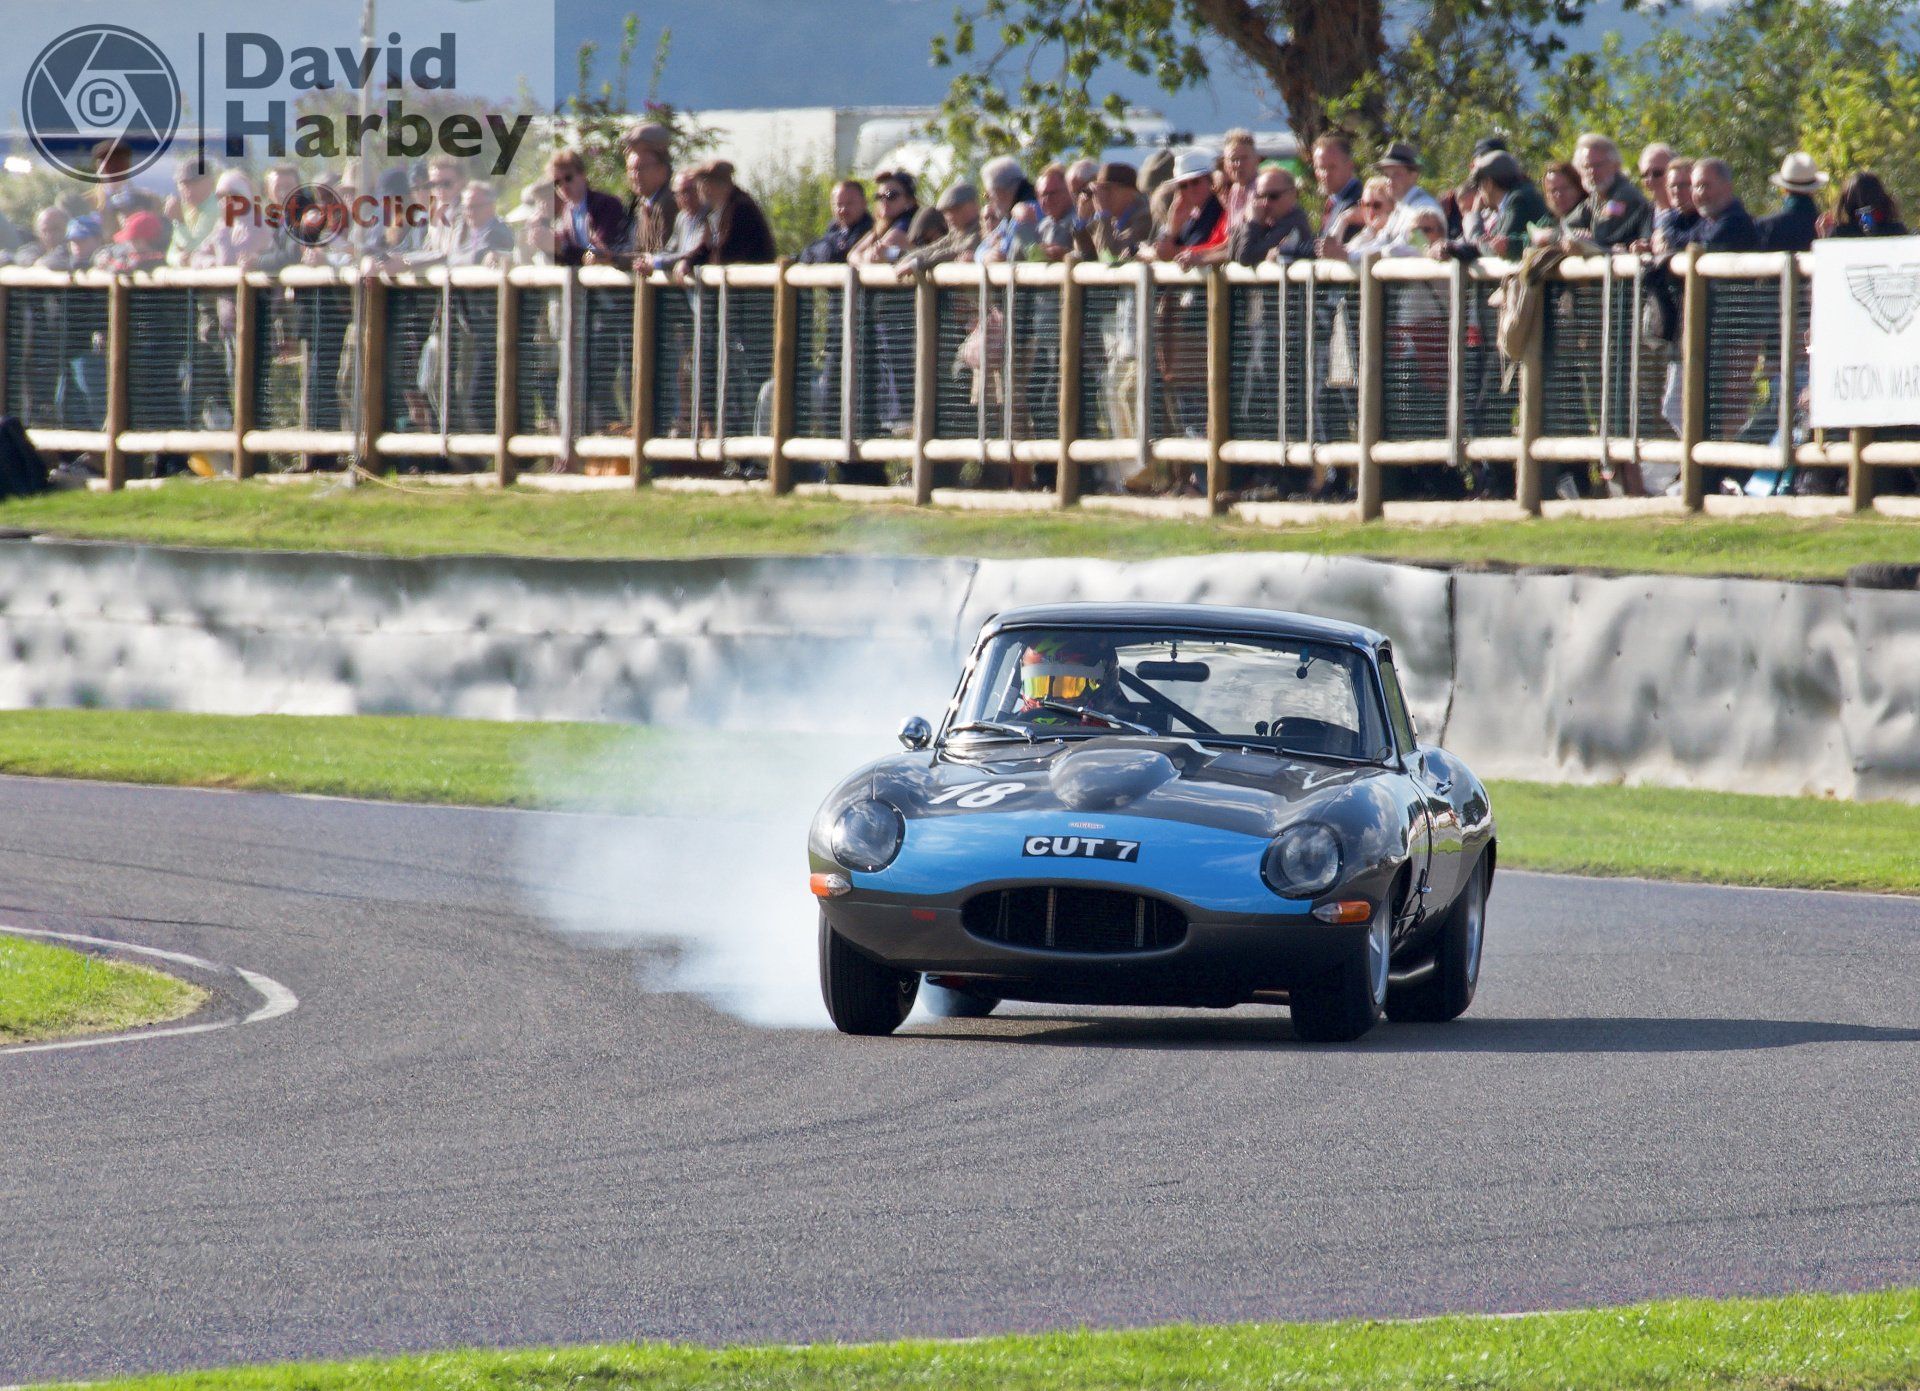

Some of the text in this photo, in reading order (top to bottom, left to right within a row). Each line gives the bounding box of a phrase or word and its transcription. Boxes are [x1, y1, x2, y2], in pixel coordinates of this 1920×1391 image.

[1833, 364, 1884, 401] ASTON
[928, 781, 1026, 808] 18
[1025, 836, 1139, 860] CUT 7
